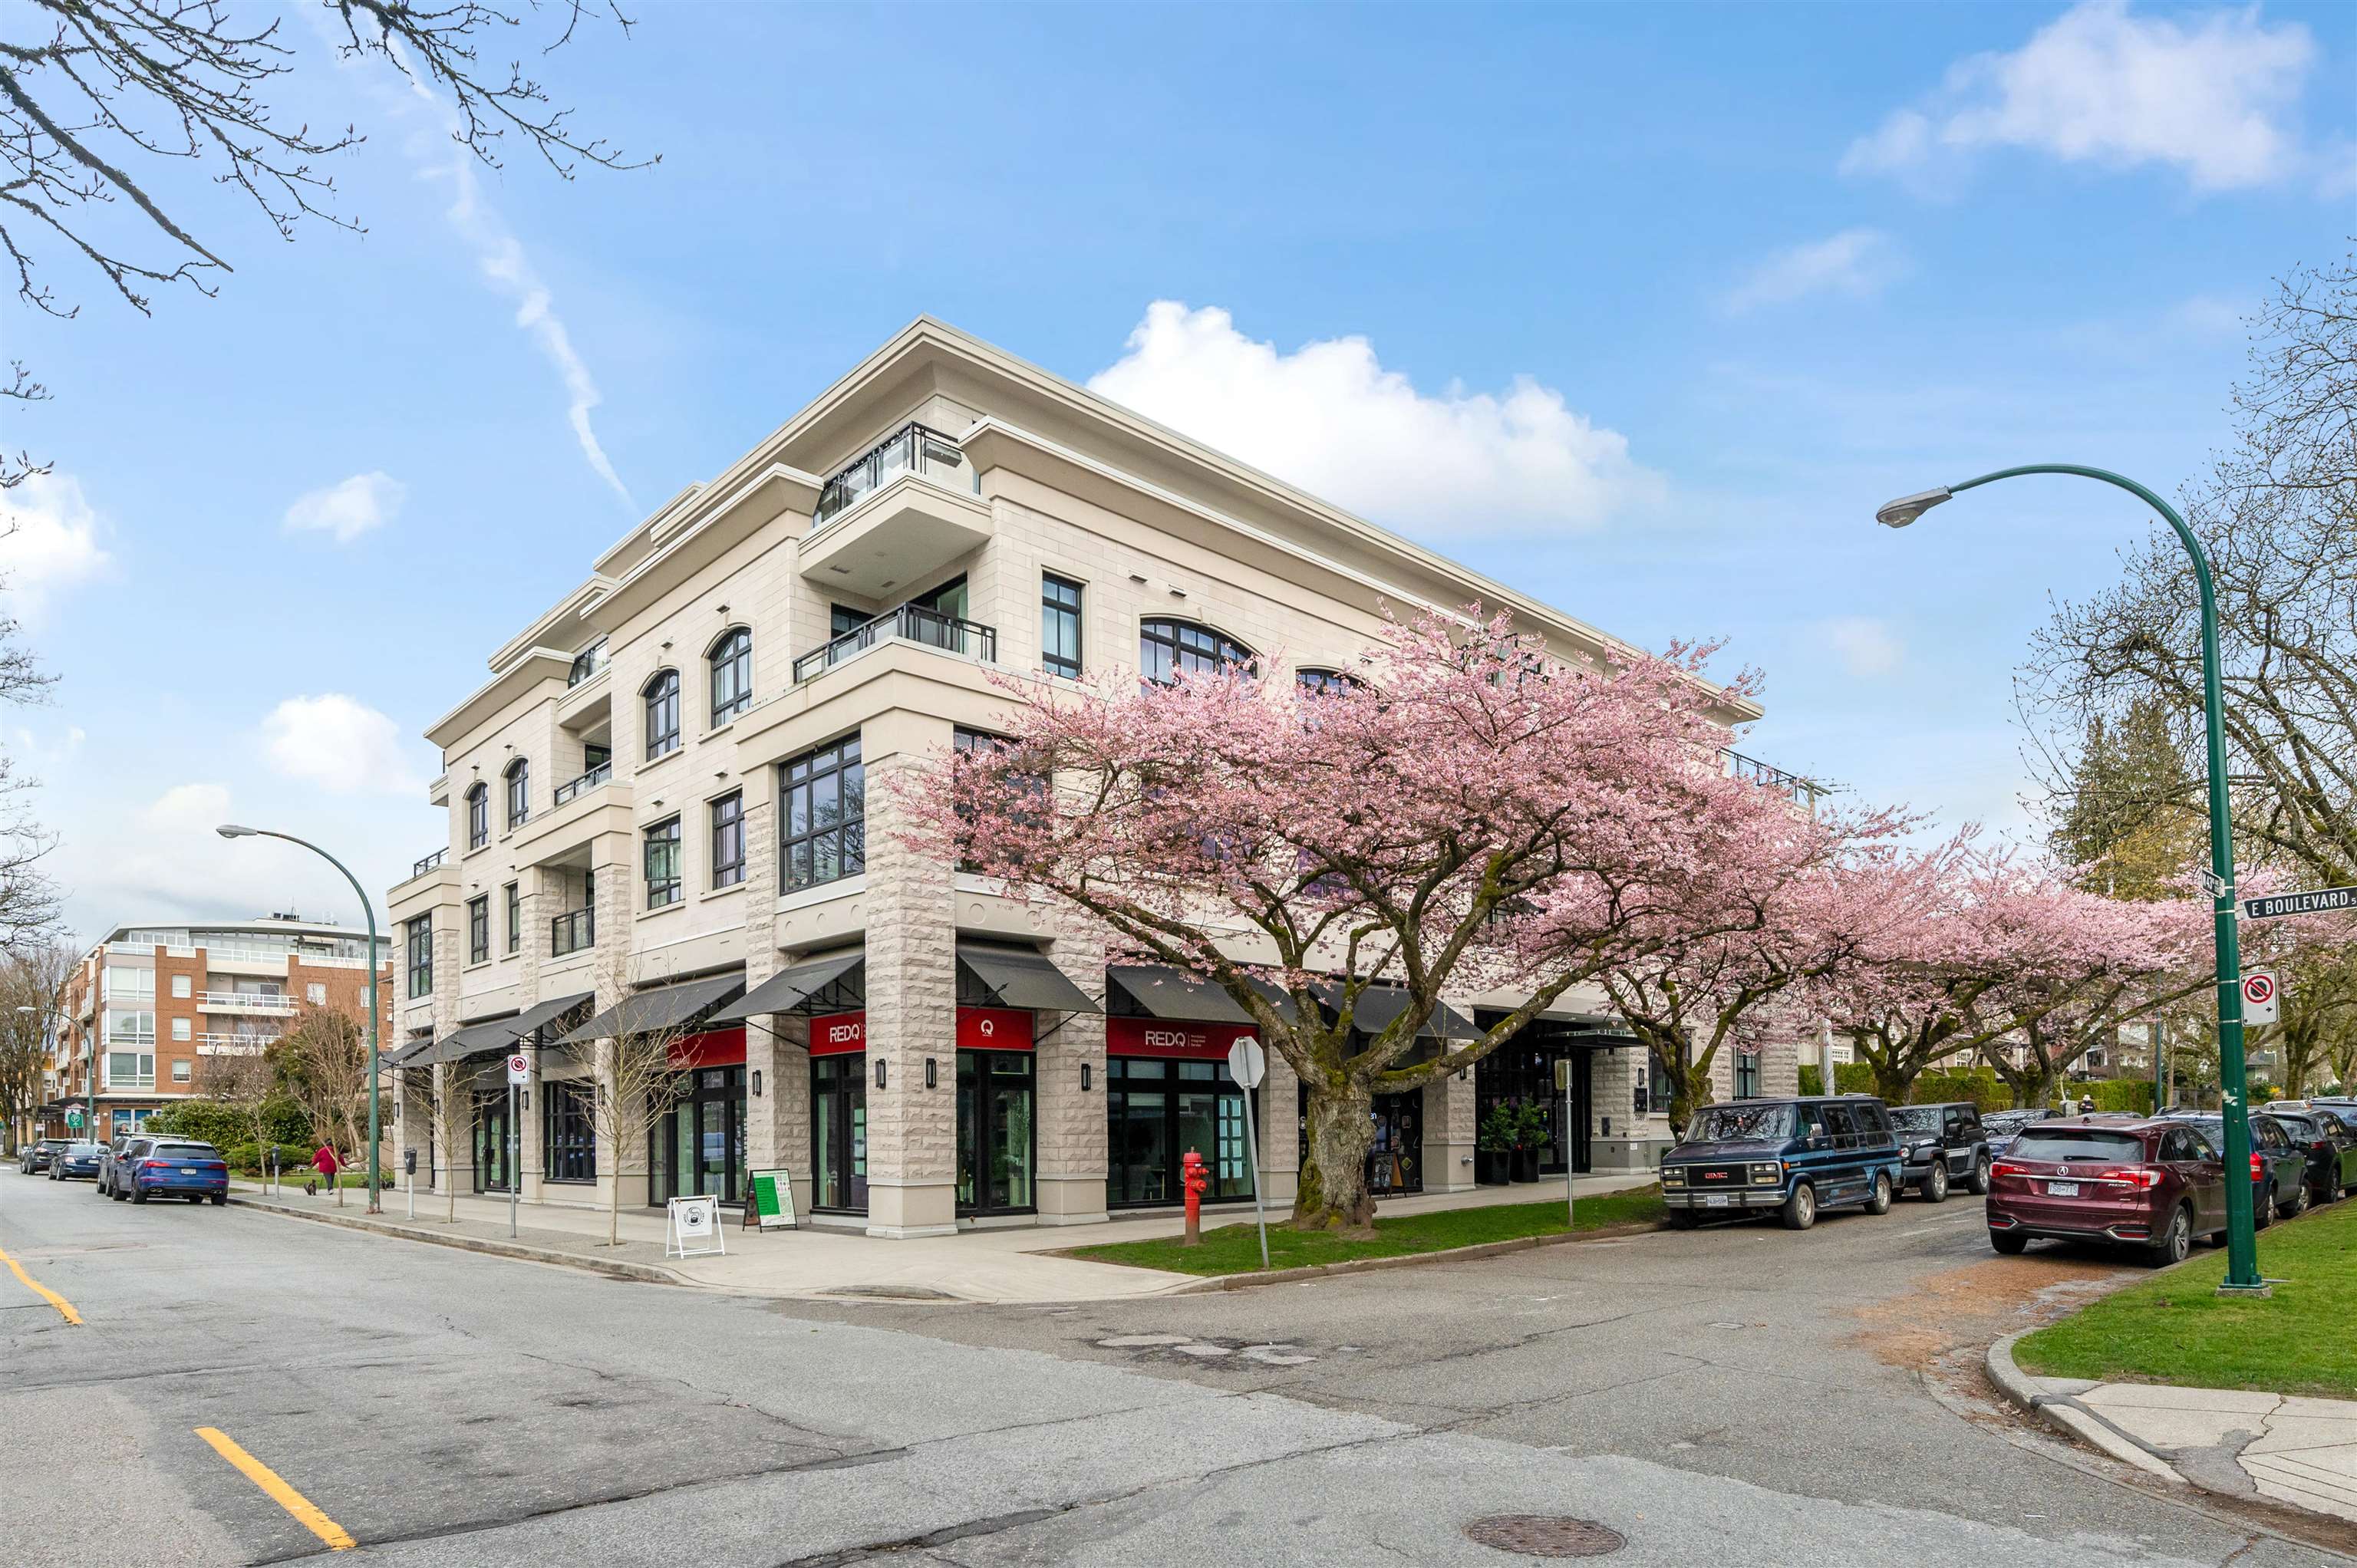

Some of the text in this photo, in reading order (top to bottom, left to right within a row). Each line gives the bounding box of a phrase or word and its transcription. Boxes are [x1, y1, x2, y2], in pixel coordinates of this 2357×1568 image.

[2252, 902, 2259, 916] E
[2266, 891, 2348, 914] BOULEVARD
[829, 1023, 860, 1043] REDQ
[1146, 1030, 1185, 1047] REDQ
